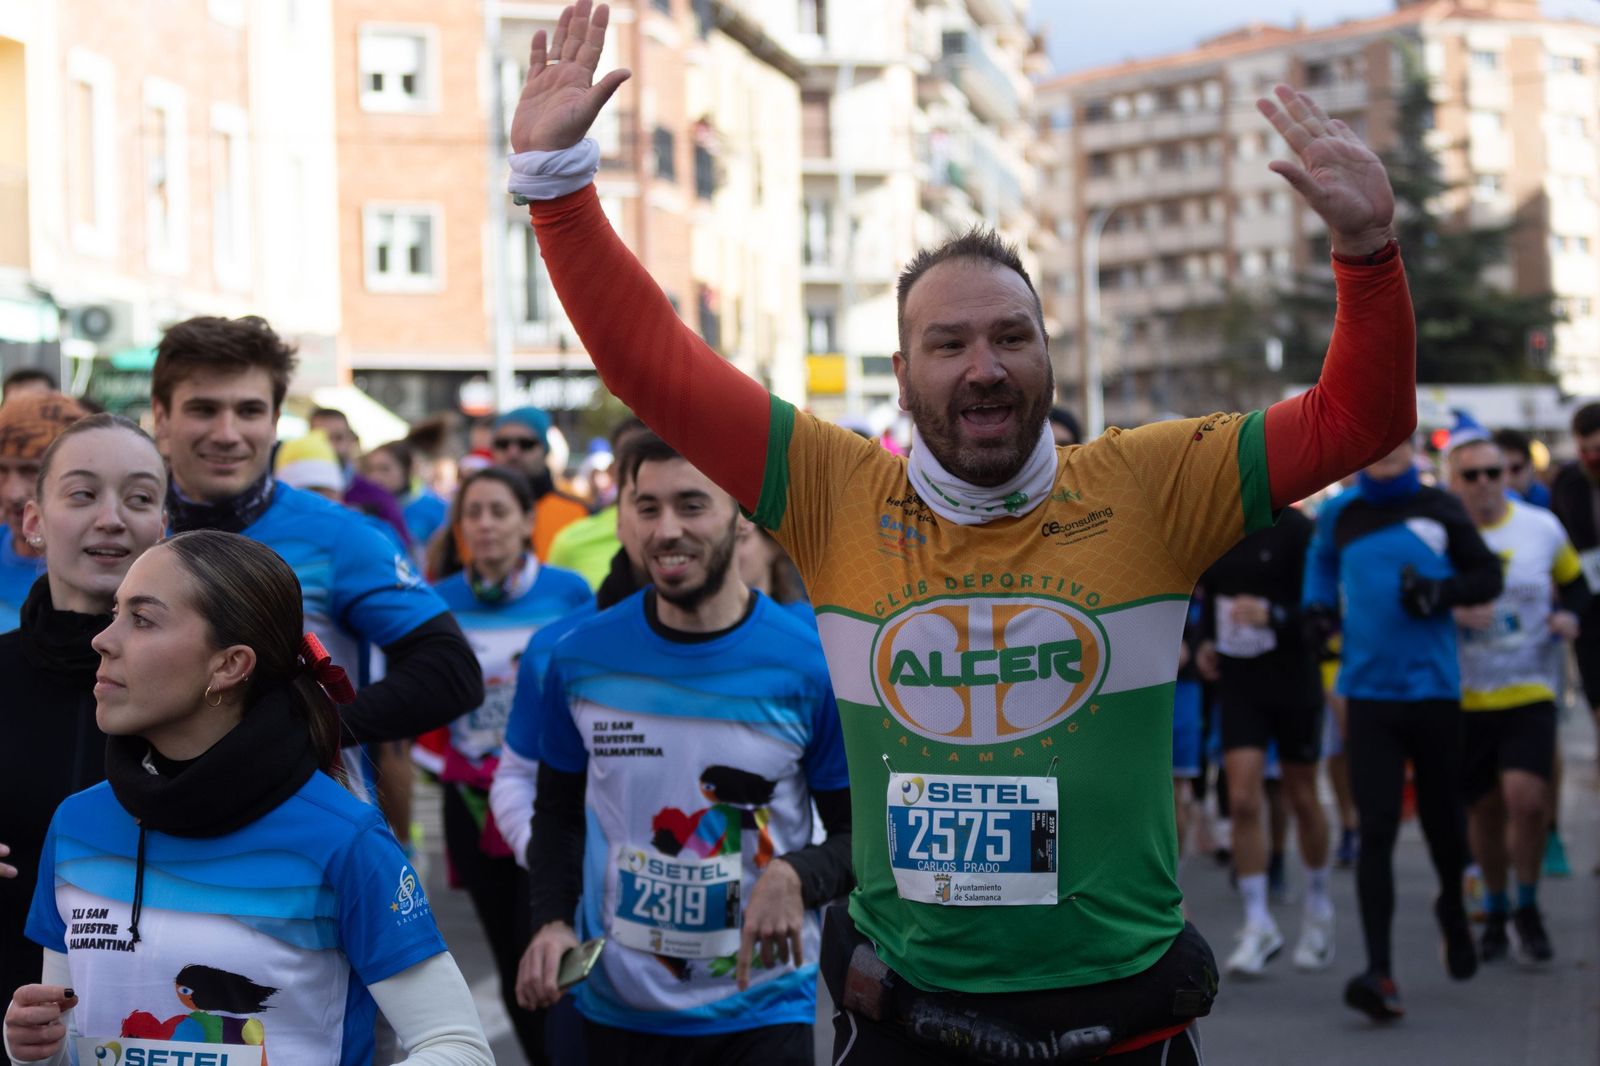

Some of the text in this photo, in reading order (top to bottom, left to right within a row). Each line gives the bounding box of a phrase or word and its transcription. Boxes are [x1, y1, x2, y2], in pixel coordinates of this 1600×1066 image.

[874, 572, 1101, 616] CLUB DEPORTIVO
[888, 638, 1085, 688] ALCER
[611, 721, 634, 731] SAN
[882, 703, 1099, 762] SALAMANCA
[593, 734, 645, 744] SILVESTRE
[594, 747, 664, 757] SALMANTINA
[928, 782, 1040, 805] SETEL
[908, 809, 1011, 862] 2575
[648, 859, 729, 881] SETEL
[917, 861, 1000, 873] CARLOS PRADO
[954, 883, 1002, 892] Ayuntamiento
[632, 876, 707, 925] 2319
[954, 894, 1002, 902] de Salamanca
[72, 908, 109, 920] XLI SAN
[71, 922, 119, 935] SILVESTRE
[69, 938, 135, 952] SALMANTINA
